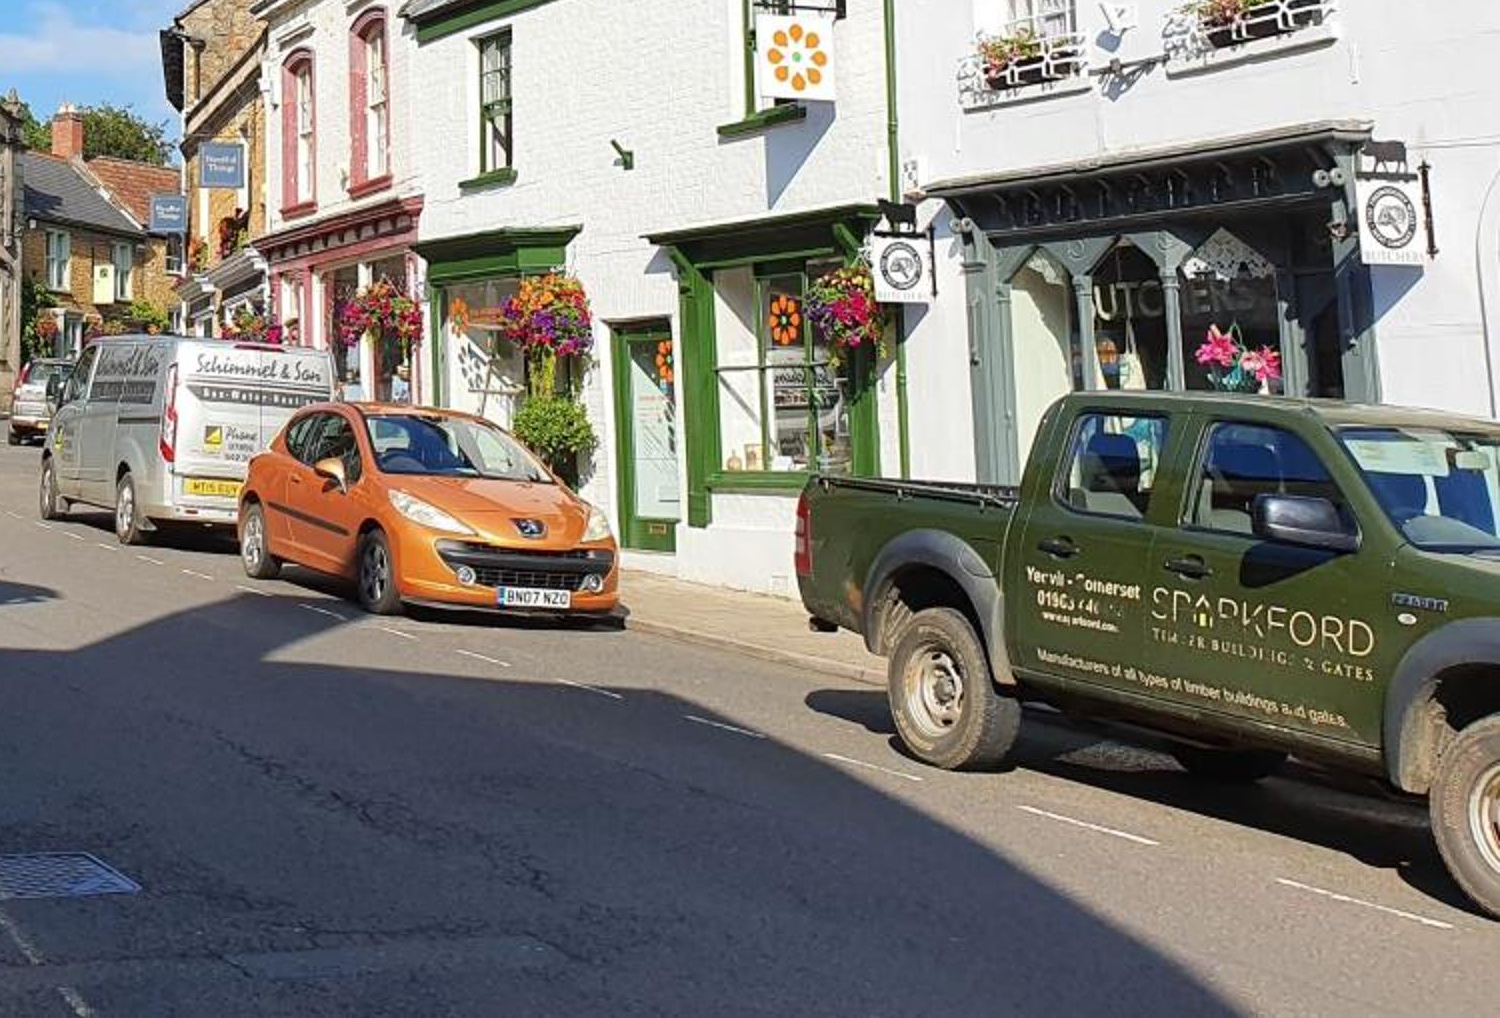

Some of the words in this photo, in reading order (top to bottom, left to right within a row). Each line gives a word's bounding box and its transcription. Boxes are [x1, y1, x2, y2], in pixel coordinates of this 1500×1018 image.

[196, 353, 277, 379] Schimmel
[280, 363, 291, 379] &
[294, 361, 321, 382] Son
[507, 589, 540, 604] BN07
[1152, 627, 1206, 649] TIMER
[1211, 641, 1293, 665] BUILIG
[1321, 660, 1374, 682] GATES
[1137, 670, 1169, 687] types
[1183, 679, 1221, 700] timber
[1222, 687, 1279, 713] buildings
